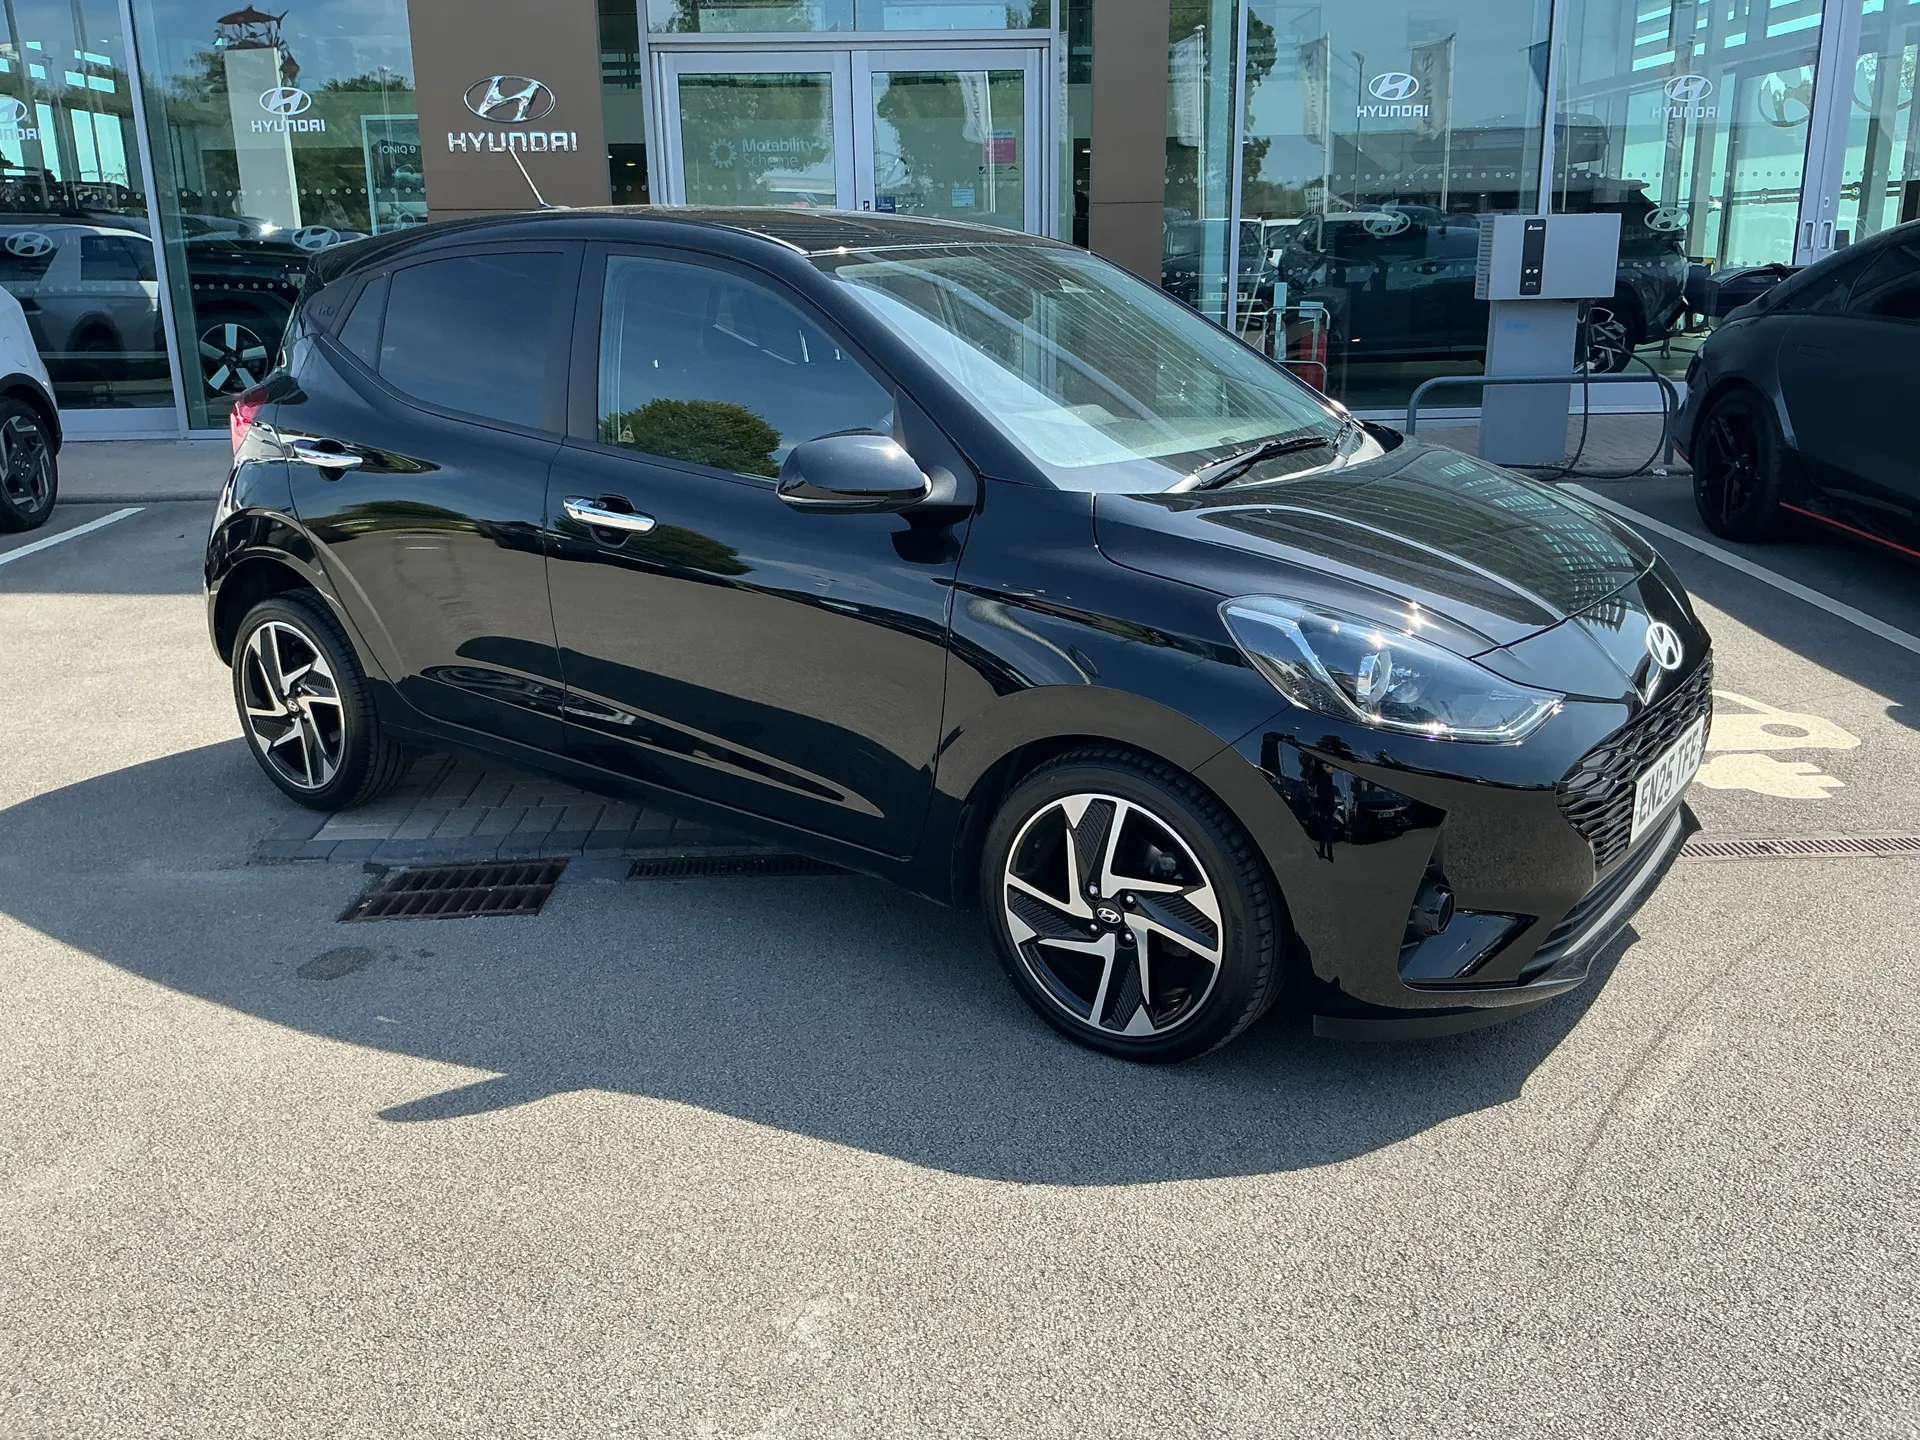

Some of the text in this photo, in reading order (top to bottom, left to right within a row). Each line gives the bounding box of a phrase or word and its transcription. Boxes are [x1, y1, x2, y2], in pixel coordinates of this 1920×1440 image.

[1356, 104, 1429, 118] HYUNDAI
[1651, 106, 1721, 118] HYUNDAI
[251, 119, 326, 132] HYUNDAI
[448, 132, 578, 152] HYUNDAI
[742, 138, 813, 155] Motability
[379, 144, 417, 155] IONIQ 9
[1639, 727, 1699, 825] EN25 TFE
